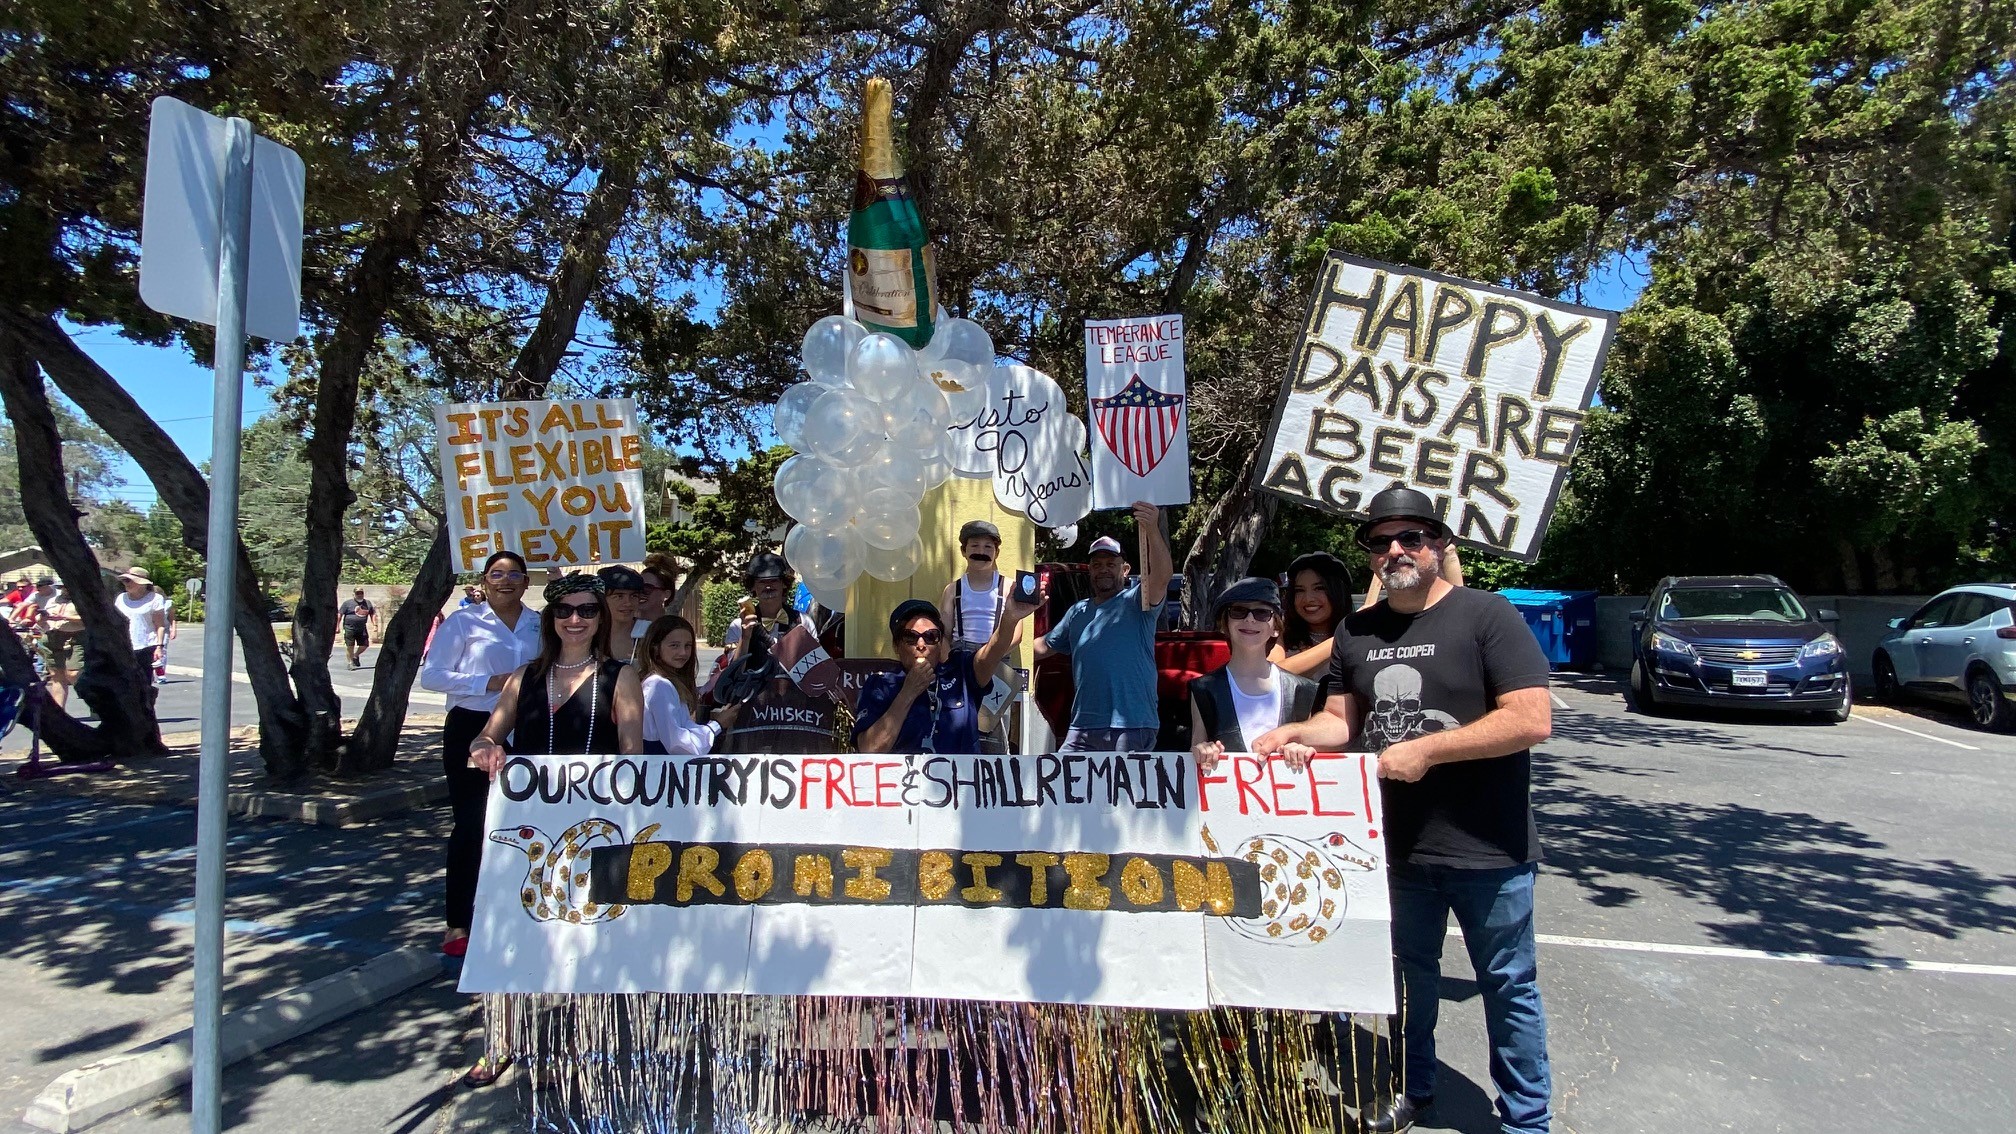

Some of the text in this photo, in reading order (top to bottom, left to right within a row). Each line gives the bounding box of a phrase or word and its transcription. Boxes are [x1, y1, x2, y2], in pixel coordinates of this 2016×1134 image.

[1085, 319, 1180, 345] TEMPERANCE
[1101, 344, 1173, 364] LEAGUE
[1307, 259, 1592, 400] HAPPY
[446, 404, 623, 445] IT'S ALL
[1291, 341, 1588, 466] DAYS ARE
[454, 435, 643, 491] FLEXIBLE
[975, 429, 1028, 478] 90
[1305, 407, 1519, 512] BEER
[461, 482, 632, 530] IF YOU
[1262, 452, 1519, 550] AGIN
[1366, 643, 1435, 662] ALICE COOPER
[752, 706, 824, 726] WHISKEY
[801, 758, 902, 809] FREE
